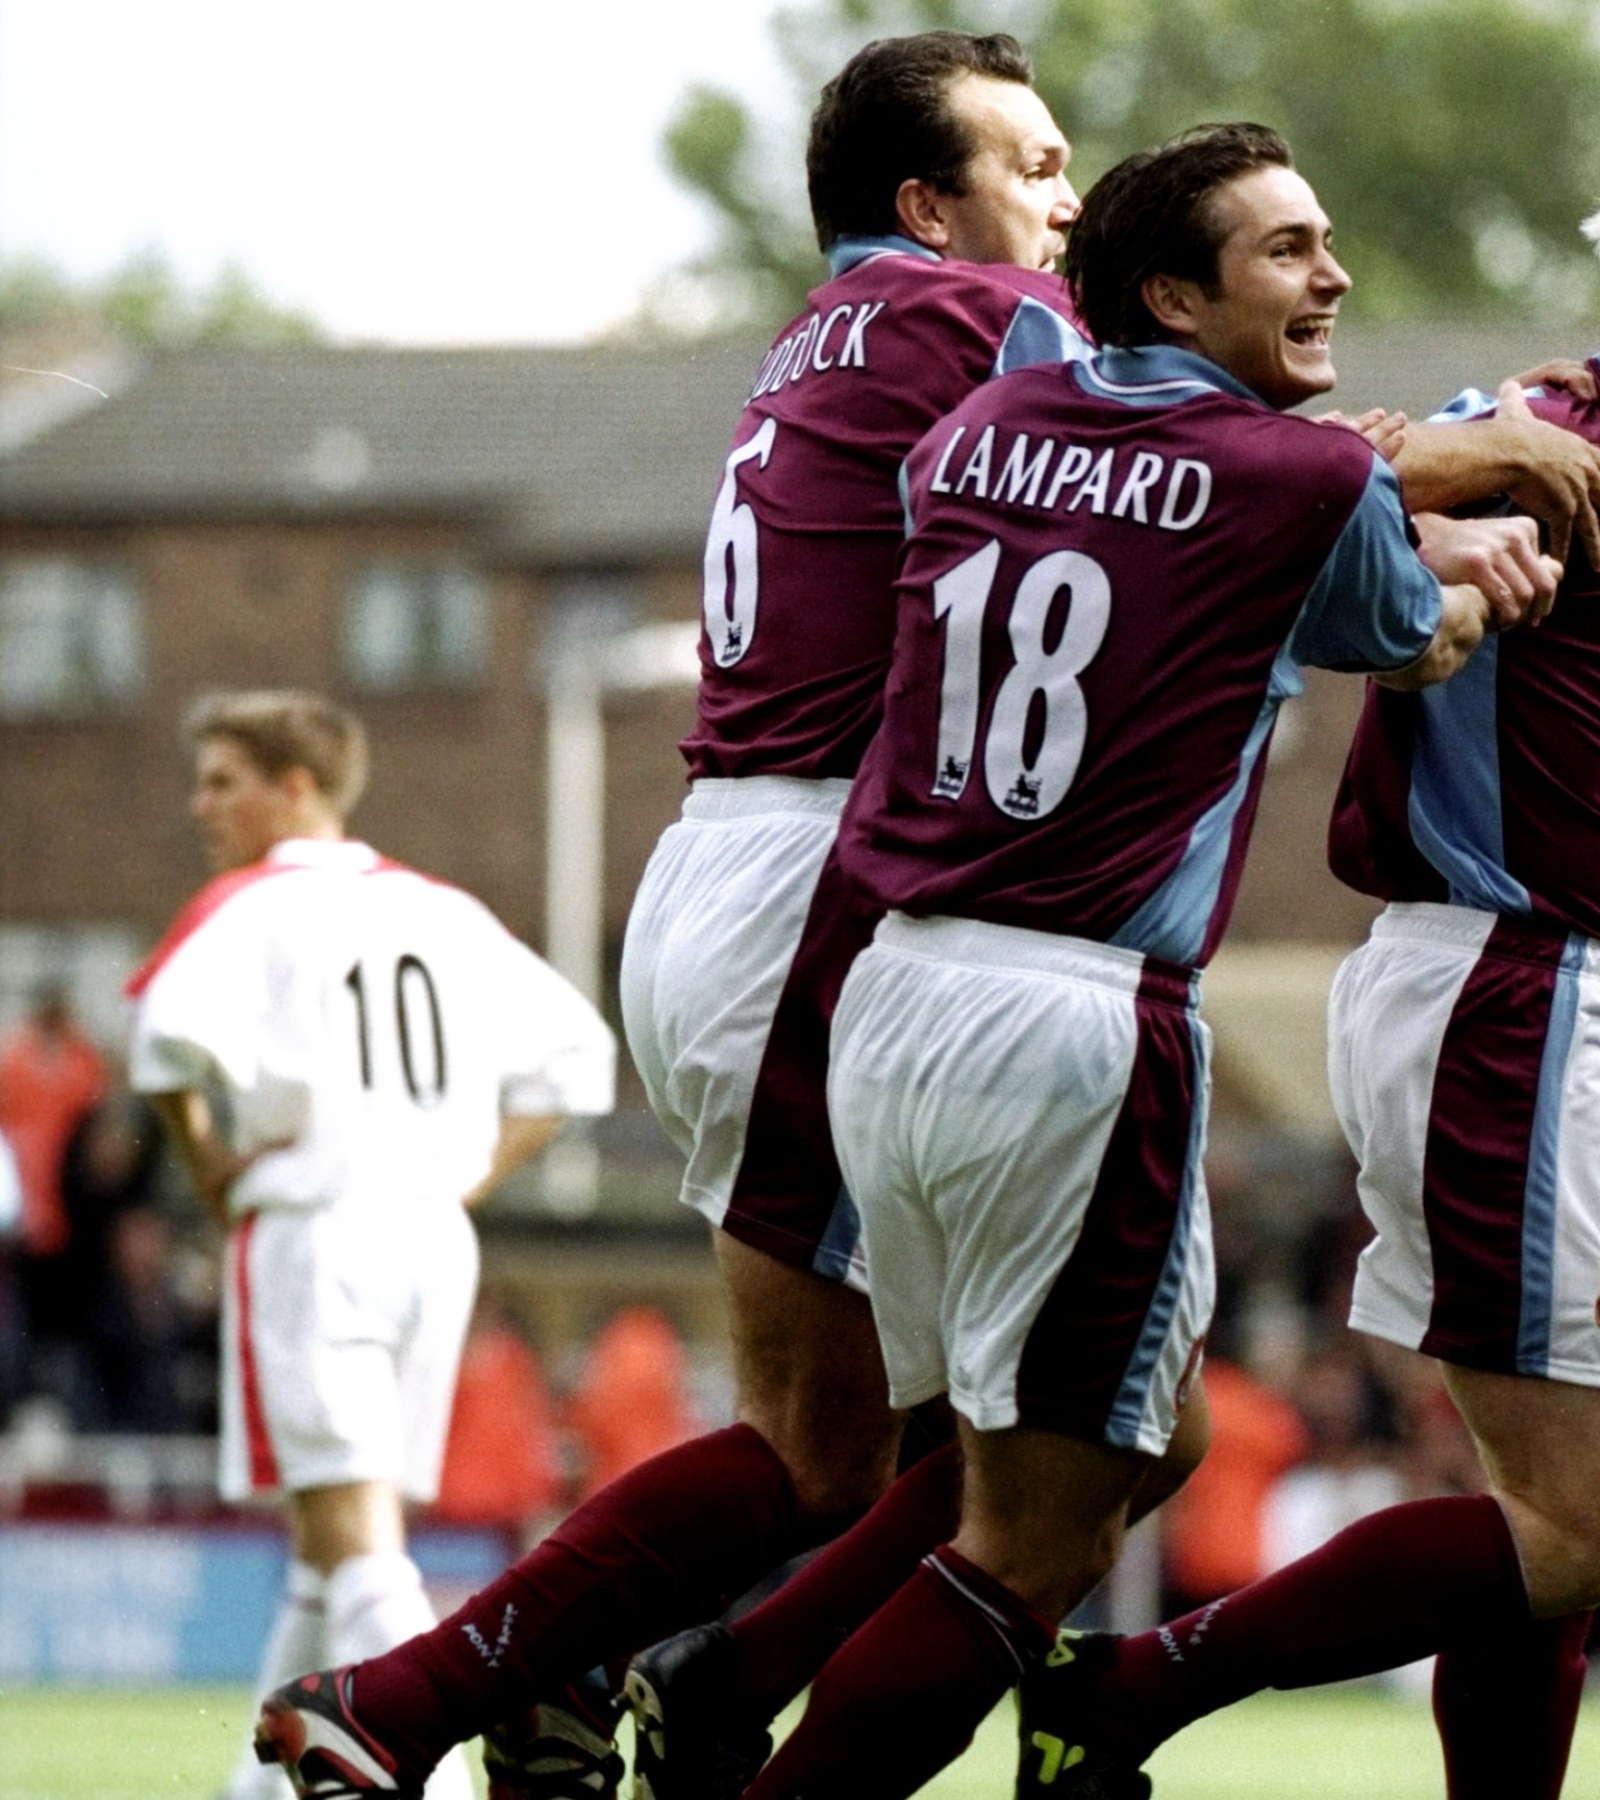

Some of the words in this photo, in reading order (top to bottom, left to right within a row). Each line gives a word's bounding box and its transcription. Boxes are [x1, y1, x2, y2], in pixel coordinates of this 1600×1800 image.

[703, 417, 777, 668] 6
[930, 425, 1213, 532] LAMPARD
[931, 538, 1112, 820] 18
[343, 953, 447, 1109] 10
[461, 1624, 500, 1668] PONY
